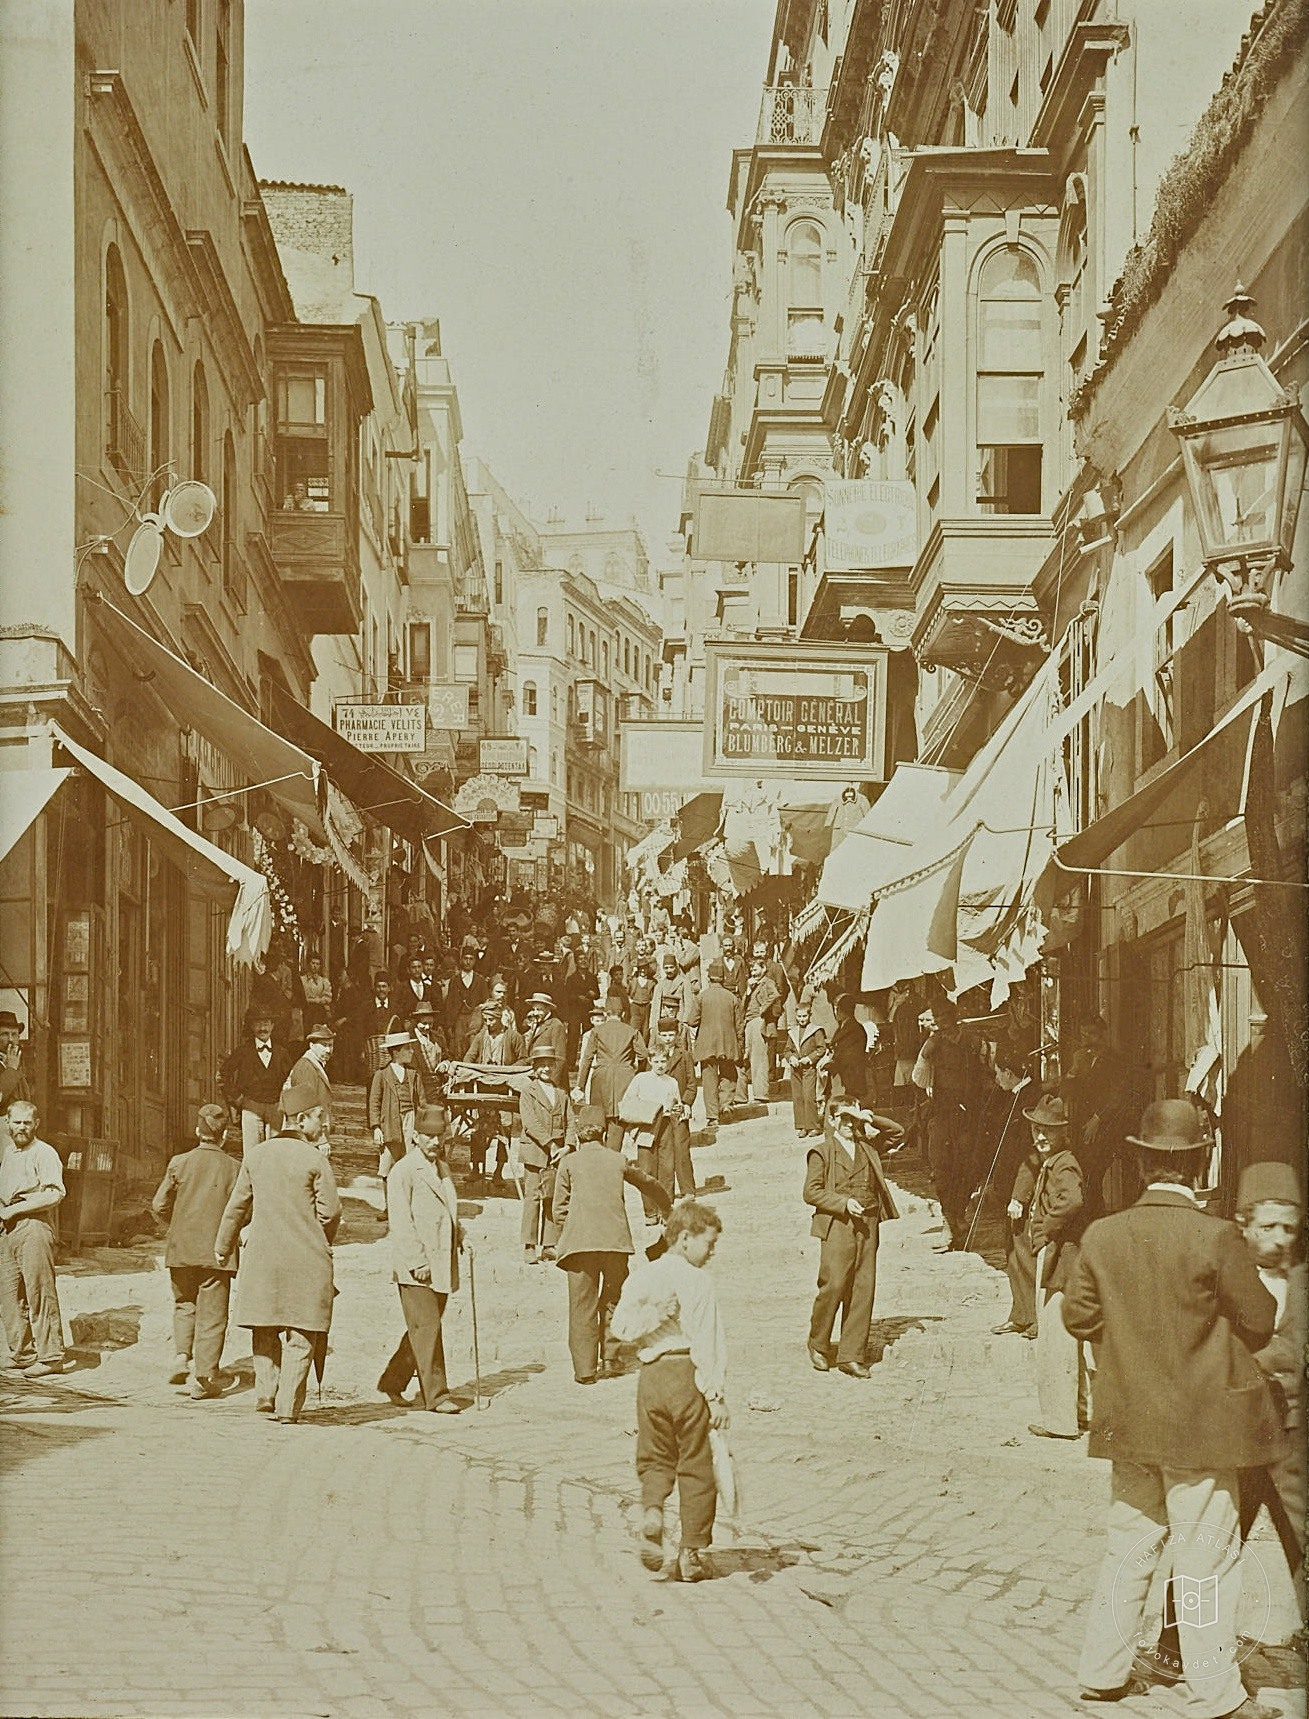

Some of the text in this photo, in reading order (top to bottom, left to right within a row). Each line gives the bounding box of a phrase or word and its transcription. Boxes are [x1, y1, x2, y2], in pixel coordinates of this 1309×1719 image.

[342, 708, 354, 718] 74
[728, 698, 861, 724] COMPTOIR GÉNÉRAL
[340, 719, 422, 730] PHARMACIE VELITS
[729, 722, 778, 732] PARIS
[797, 723, 861, 735] GENÈVE
[347, 731, 415, 741] PIERRE APERY
[728, 734, 859, 755] BLUMBERG & MELZER
